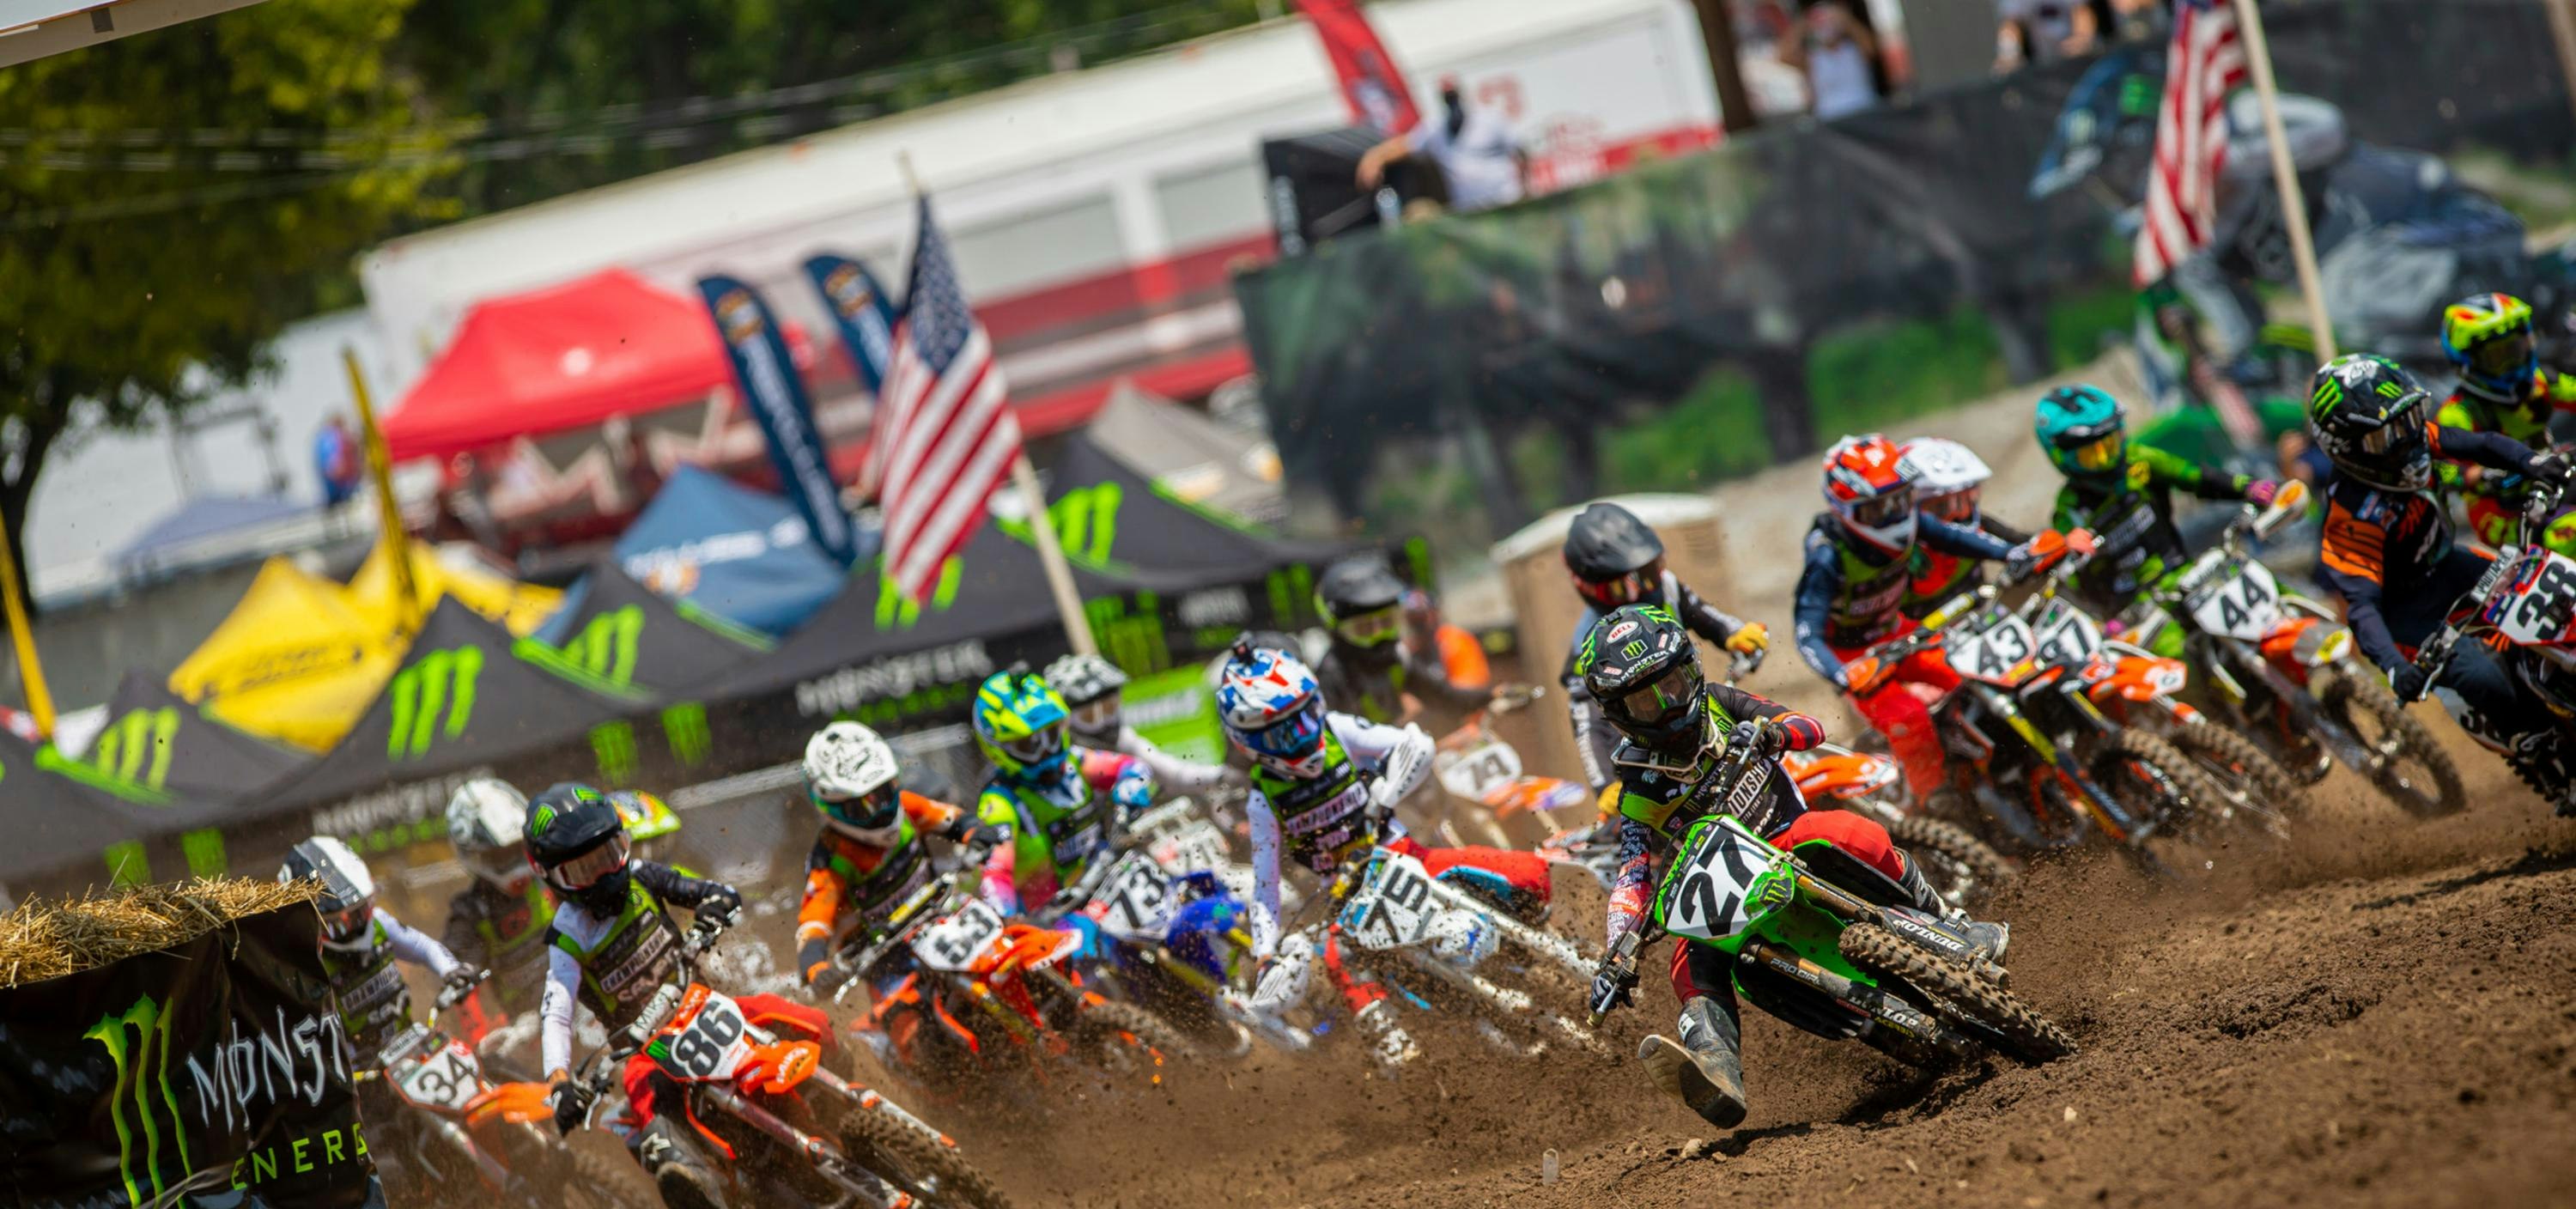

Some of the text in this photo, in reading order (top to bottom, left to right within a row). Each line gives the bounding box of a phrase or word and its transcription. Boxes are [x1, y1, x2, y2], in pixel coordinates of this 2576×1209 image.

[2219, 574, 2271, 632] 44
[2516, 561, 2576, 640] 38
[1610, 623, 1632, 639] BELL
[1978, 623, 2028, 675] 43
[1620, 650, 1668, 682] MONSTER
[1364, 864, 1430, 944] 75
[1680, 823, 1754, 937] 27
[1893, 920, 1965, 951] DUNLOP
[1770, 957, 1797, 975] PRO
[675, 1000, 743, 1078] 86
[417, 1052, 478, 1105] 34
